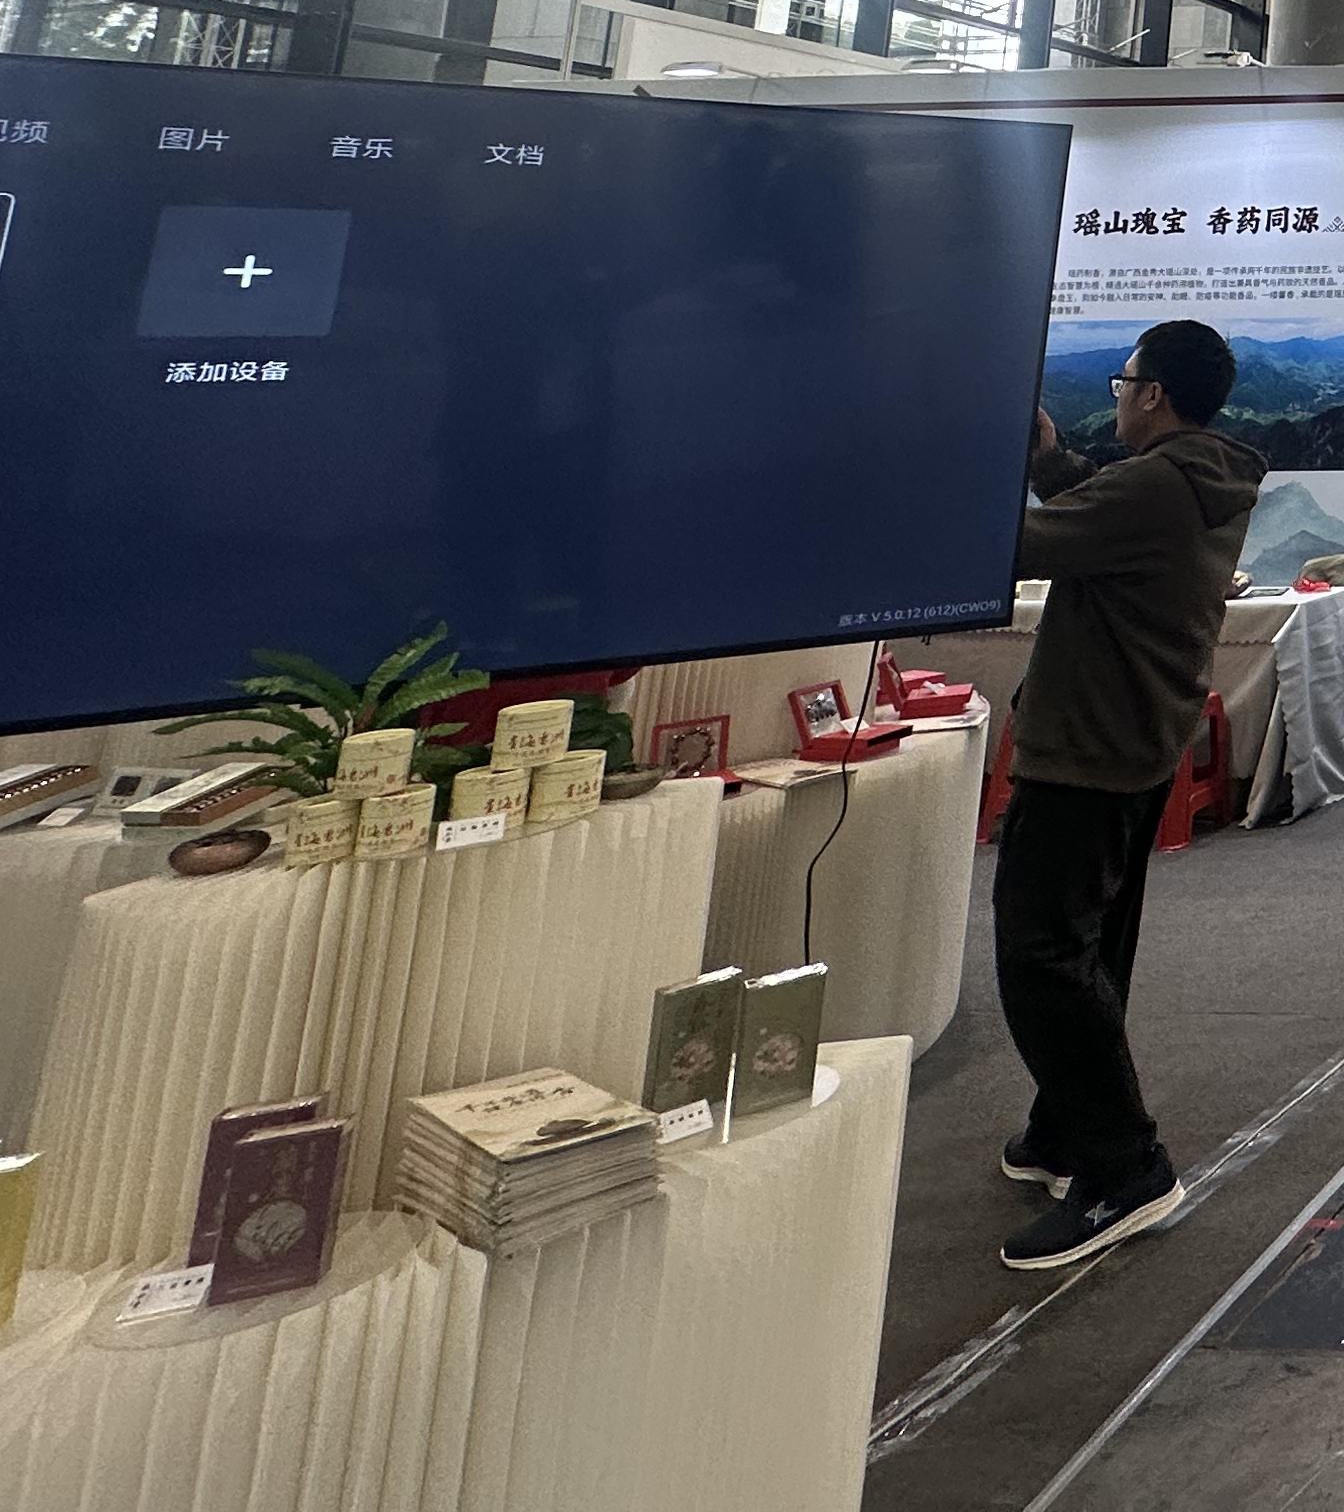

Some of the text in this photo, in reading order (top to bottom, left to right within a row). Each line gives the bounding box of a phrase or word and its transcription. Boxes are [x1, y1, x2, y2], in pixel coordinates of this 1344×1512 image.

[158, 126, 231, 154] 图片
[330, 134, 394, 161] 音乐
[485, 142, 545, 167] 文档
[1073, 206, 1321, 237] 瑶山瑰宝 香药同源
[164, 359, 290, 384] 添加设备
[838, 613, 868, 628] 版本
